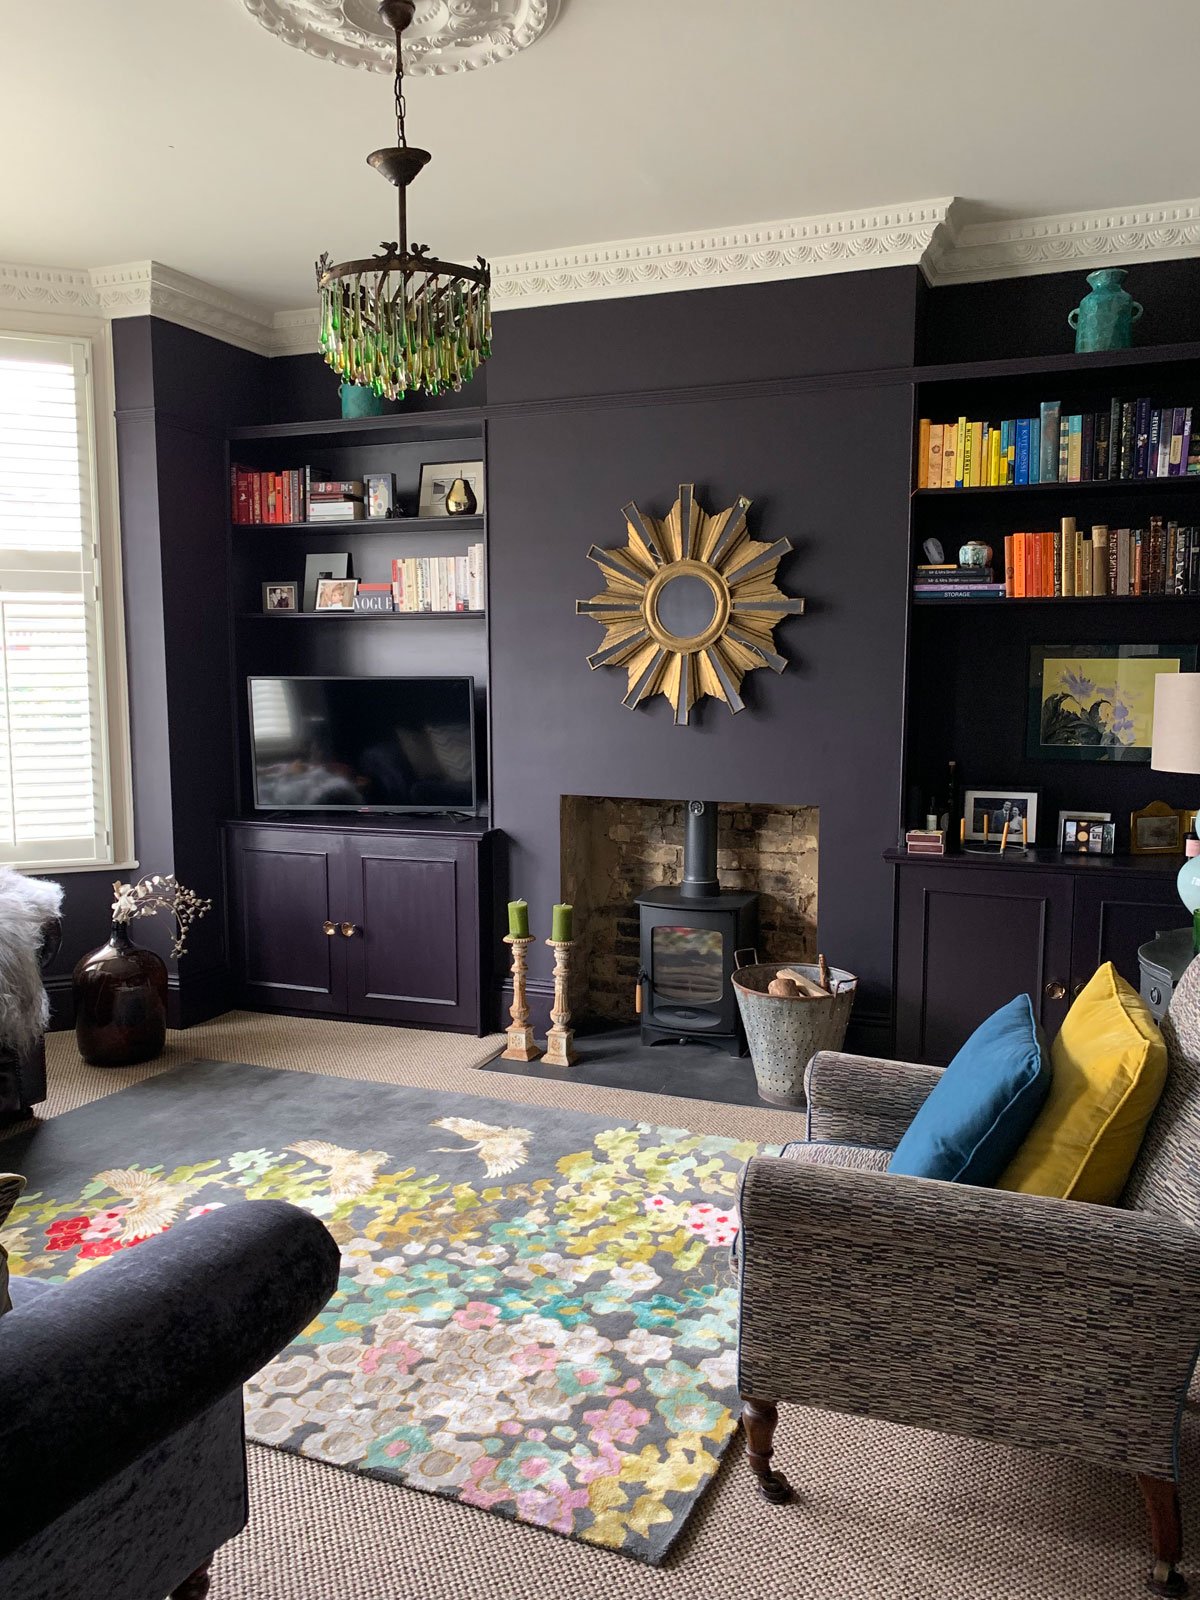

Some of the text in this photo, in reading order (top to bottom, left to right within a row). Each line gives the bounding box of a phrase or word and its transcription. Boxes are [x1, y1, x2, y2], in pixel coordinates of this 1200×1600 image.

[1109, 535, 1117, 553] ZADIE
[1109, 555, 1117, 577] SMITH
[354, 597, 393, 610] VOGUE
